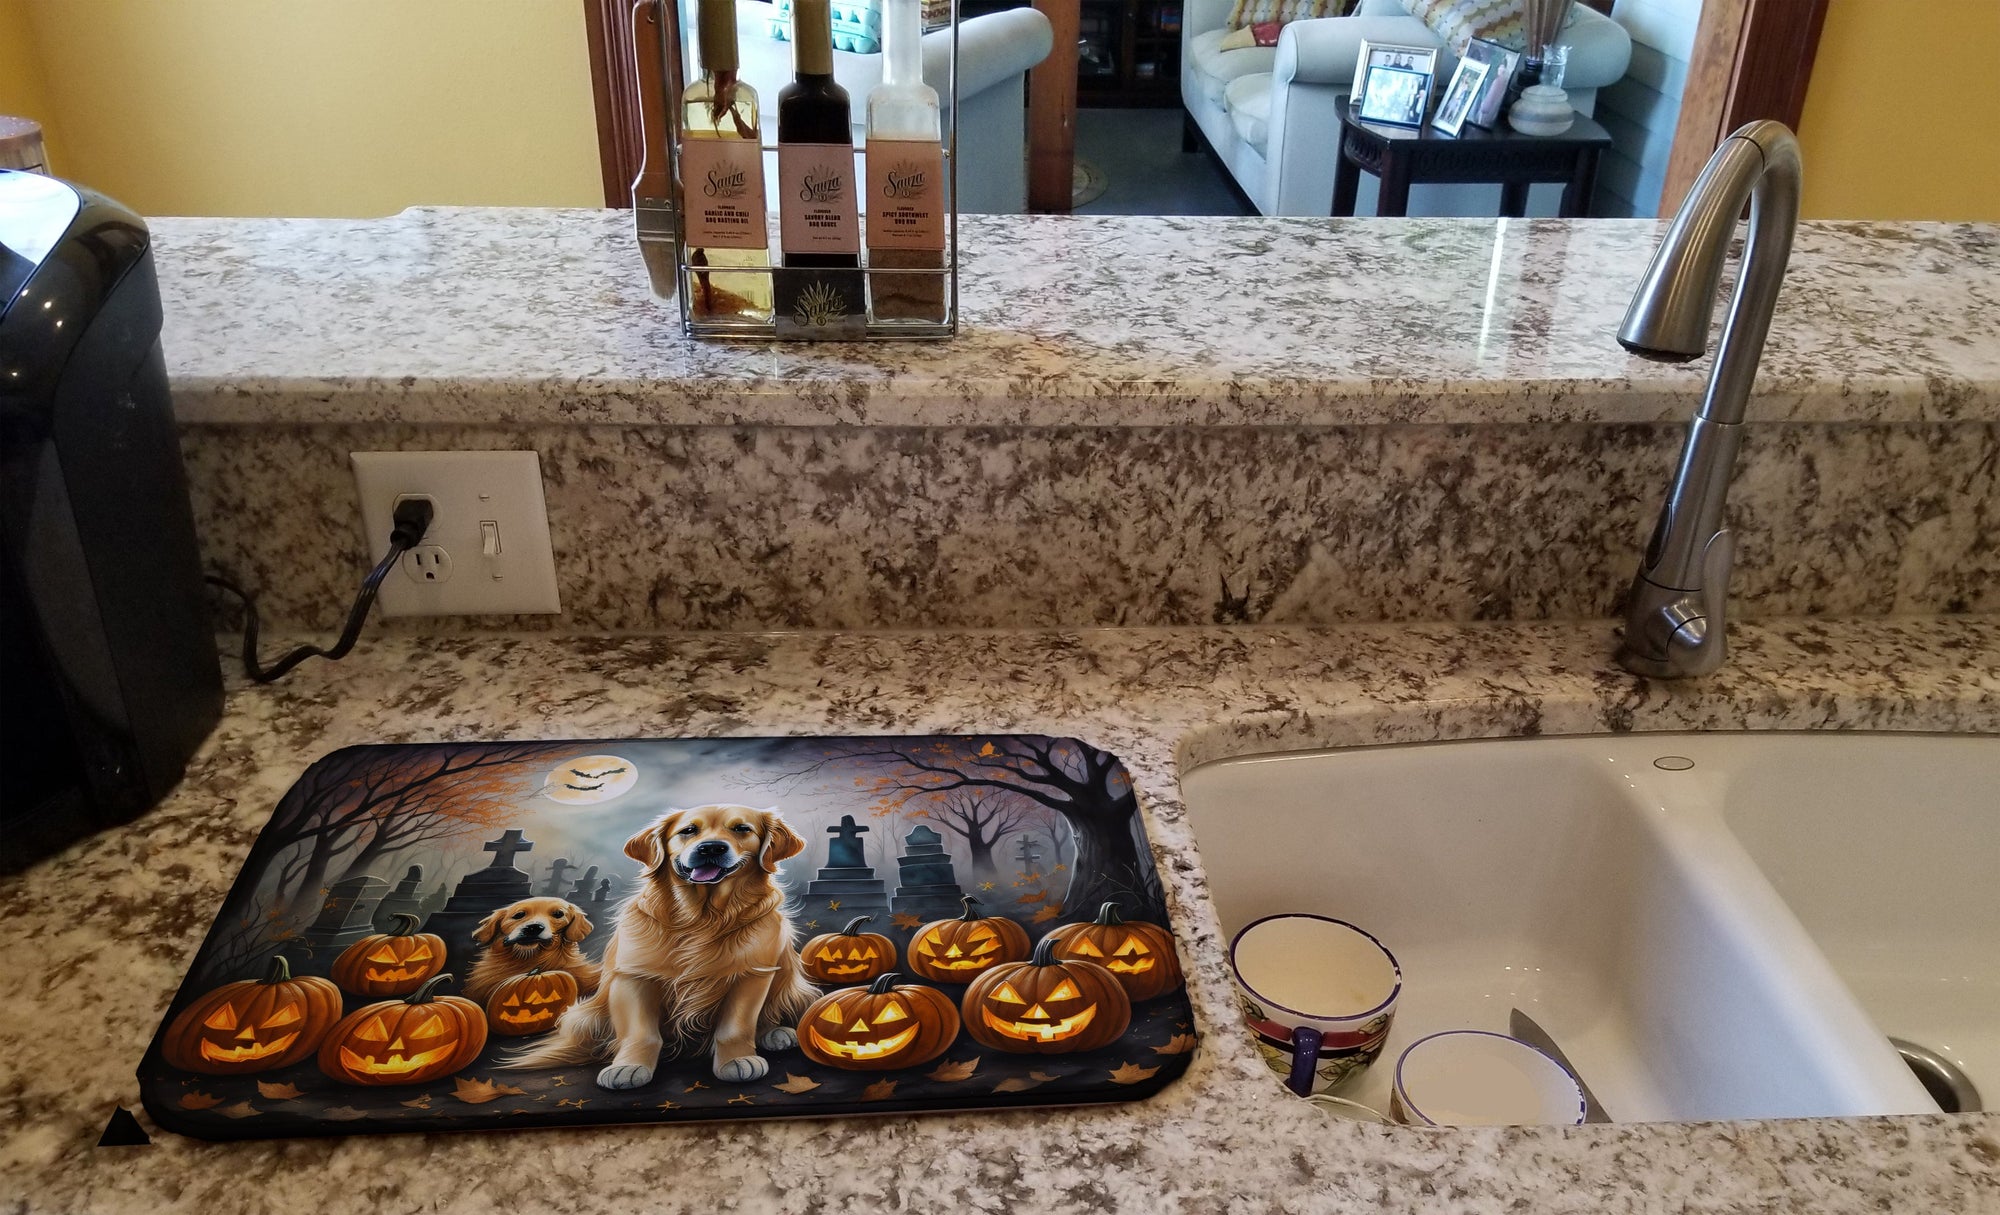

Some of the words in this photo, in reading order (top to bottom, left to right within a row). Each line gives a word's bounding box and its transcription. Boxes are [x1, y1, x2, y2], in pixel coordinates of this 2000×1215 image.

[703, 170, 745, 197] Sauza
[800, 175, 842, 202] Sauza
[883, 171, 925, 198] Sauza
[793, 294, 844, 327] Sauza
